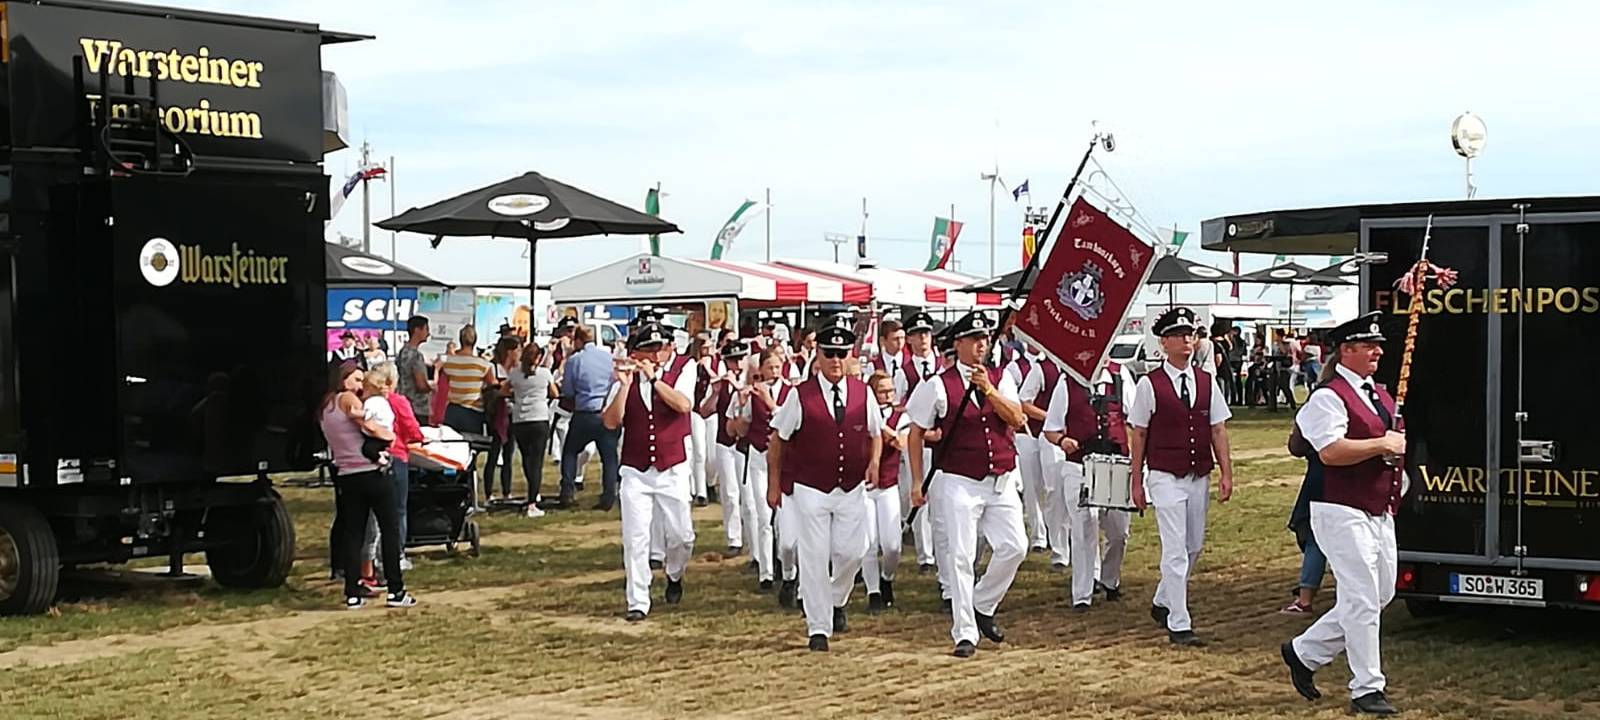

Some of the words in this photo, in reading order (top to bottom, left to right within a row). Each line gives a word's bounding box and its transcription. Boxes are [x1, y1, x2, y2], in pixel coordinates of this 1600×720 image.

[86, 95, 263, 139] morium
[179, 241, 288, 288] Warsteiner
[1418, 465, 1599, 498] WARTEINE
[1465, 577, 1484, 592] SO
[1495, 579, 1505, 594] W
[1508, 580, 1537, 596] 365
